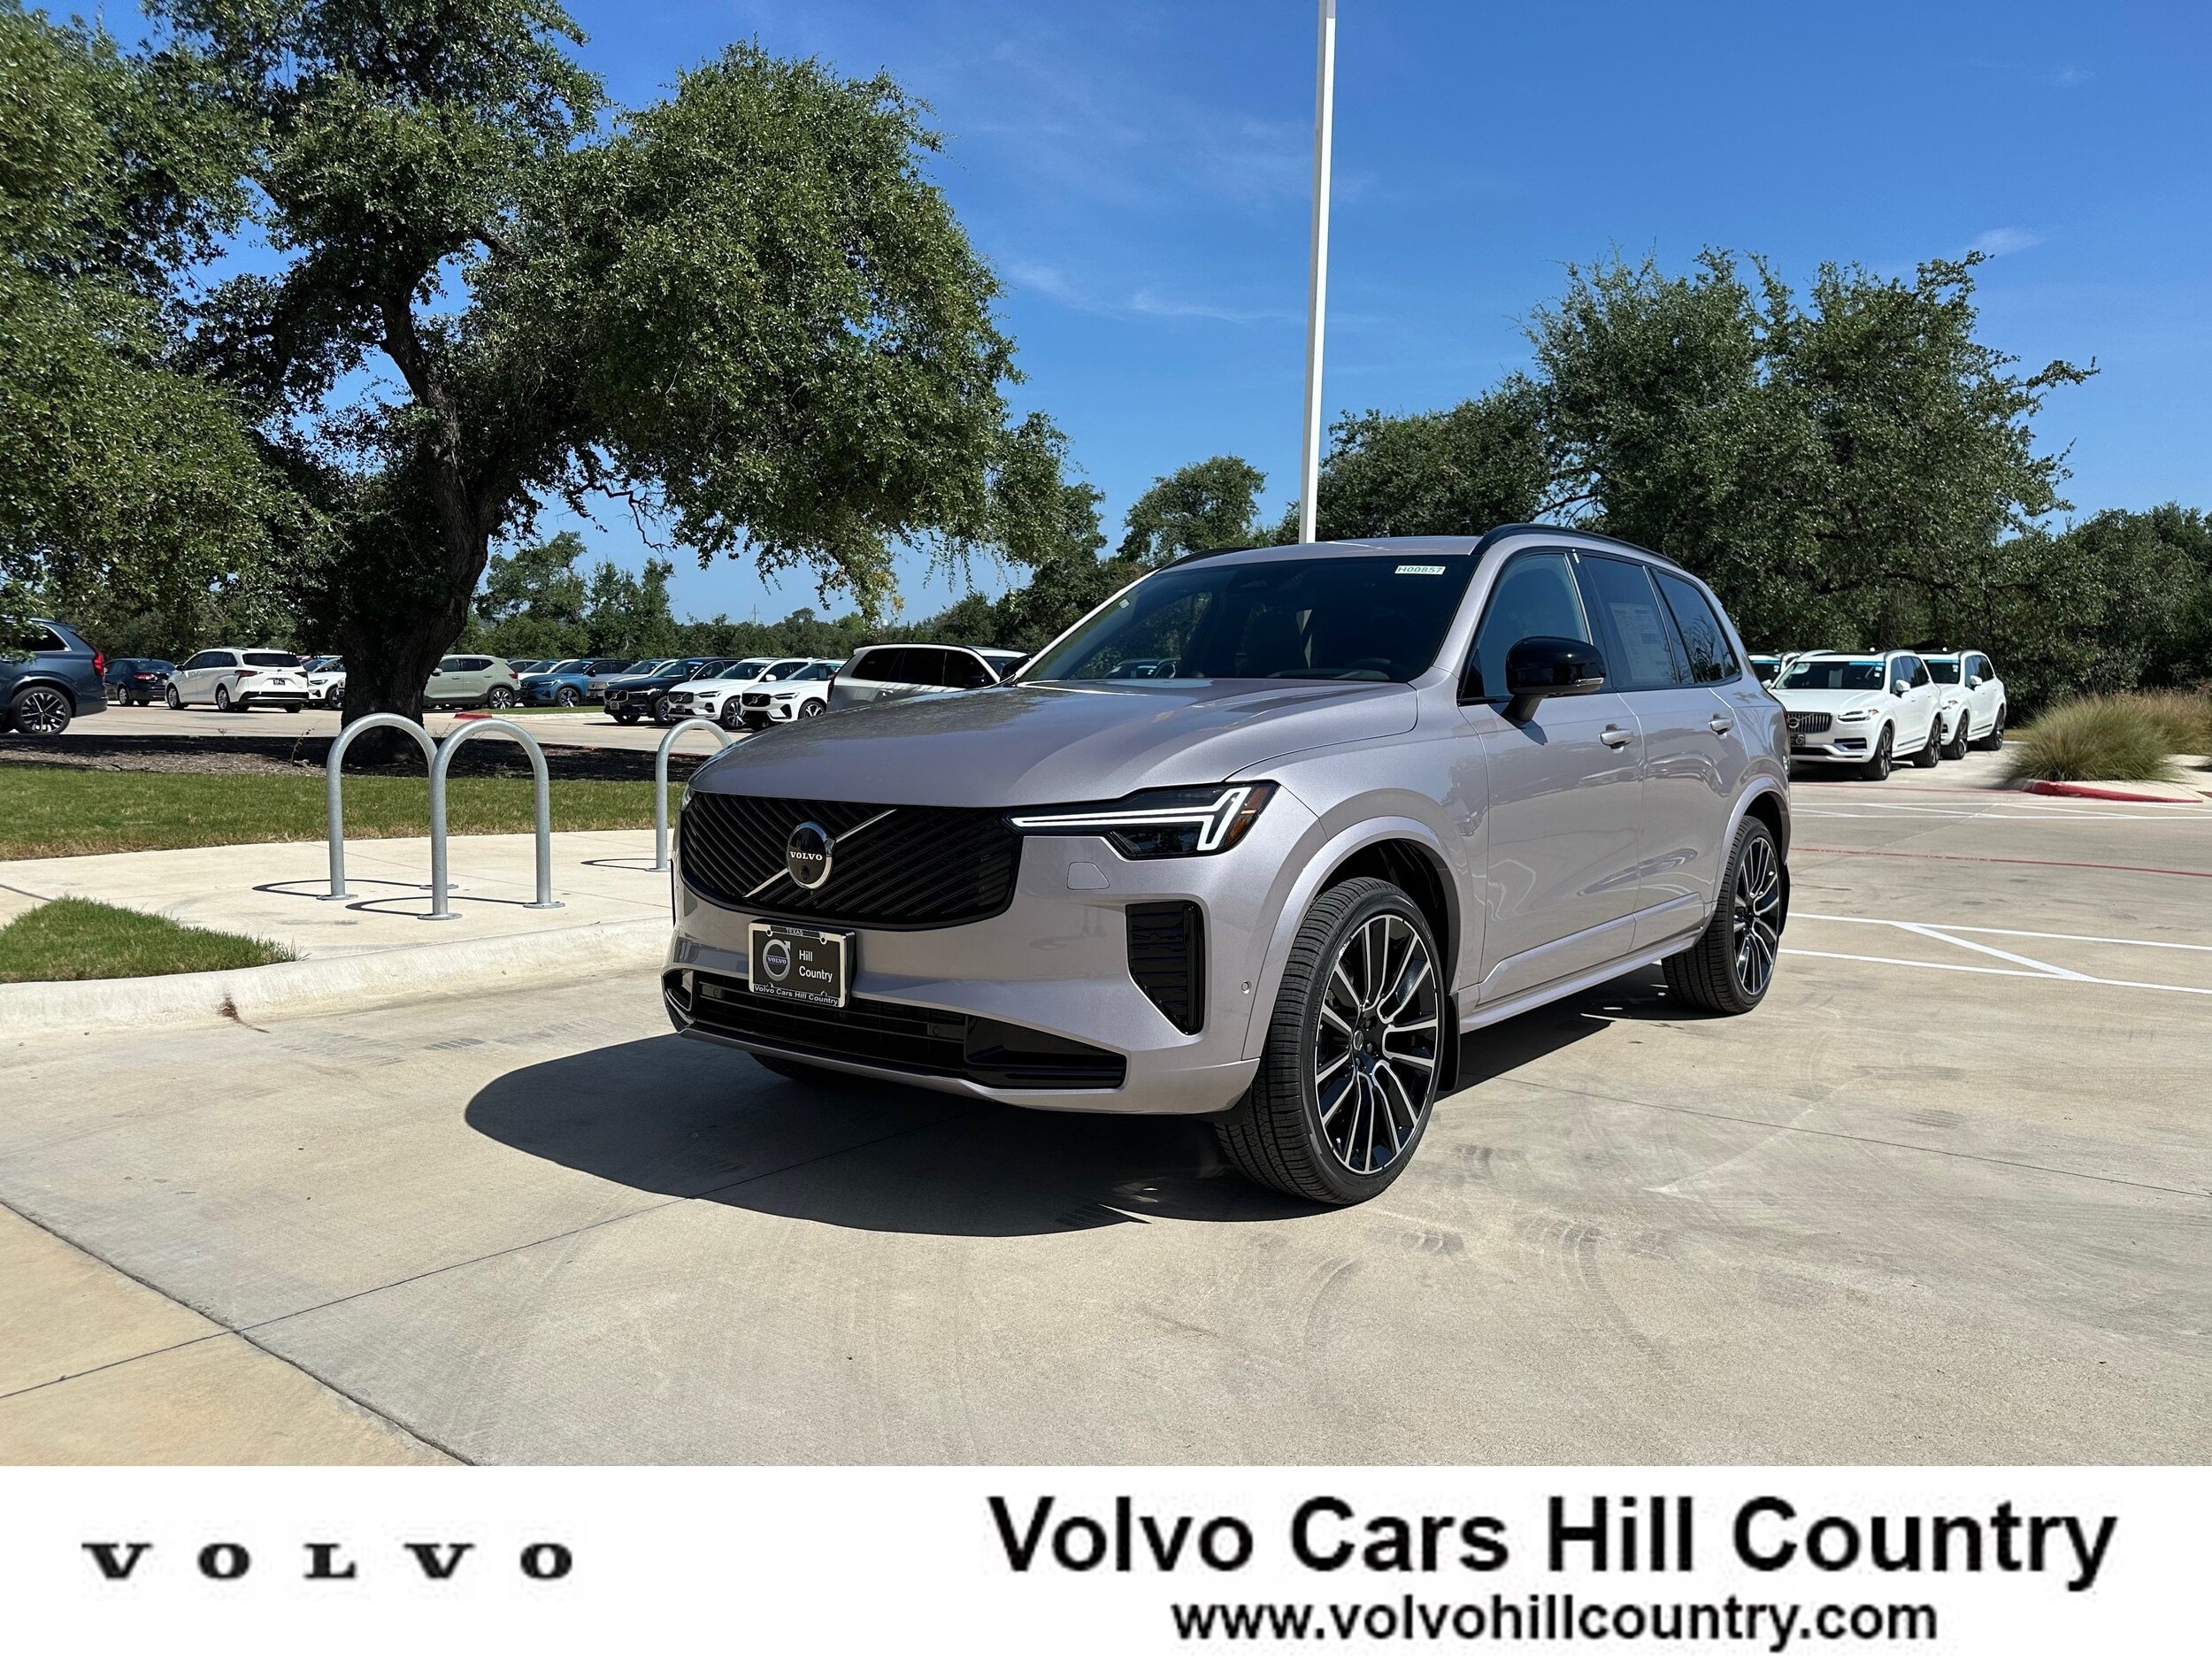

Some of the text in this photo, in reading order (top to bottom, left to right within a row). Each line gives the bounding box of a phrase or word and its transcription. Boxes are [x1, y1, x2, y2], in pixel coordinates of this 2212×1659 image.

[790, 851, 823, 861] VOLVO
[786, 927, 803, 936] TEXAS
[799, 949, 812, 961] Hill
[799, 965, 833, 983] Country
[755, 985, 775, 994] Volvo
[776, 988, 793, 997] Cars
[809, 995, 838, 1005] Country
